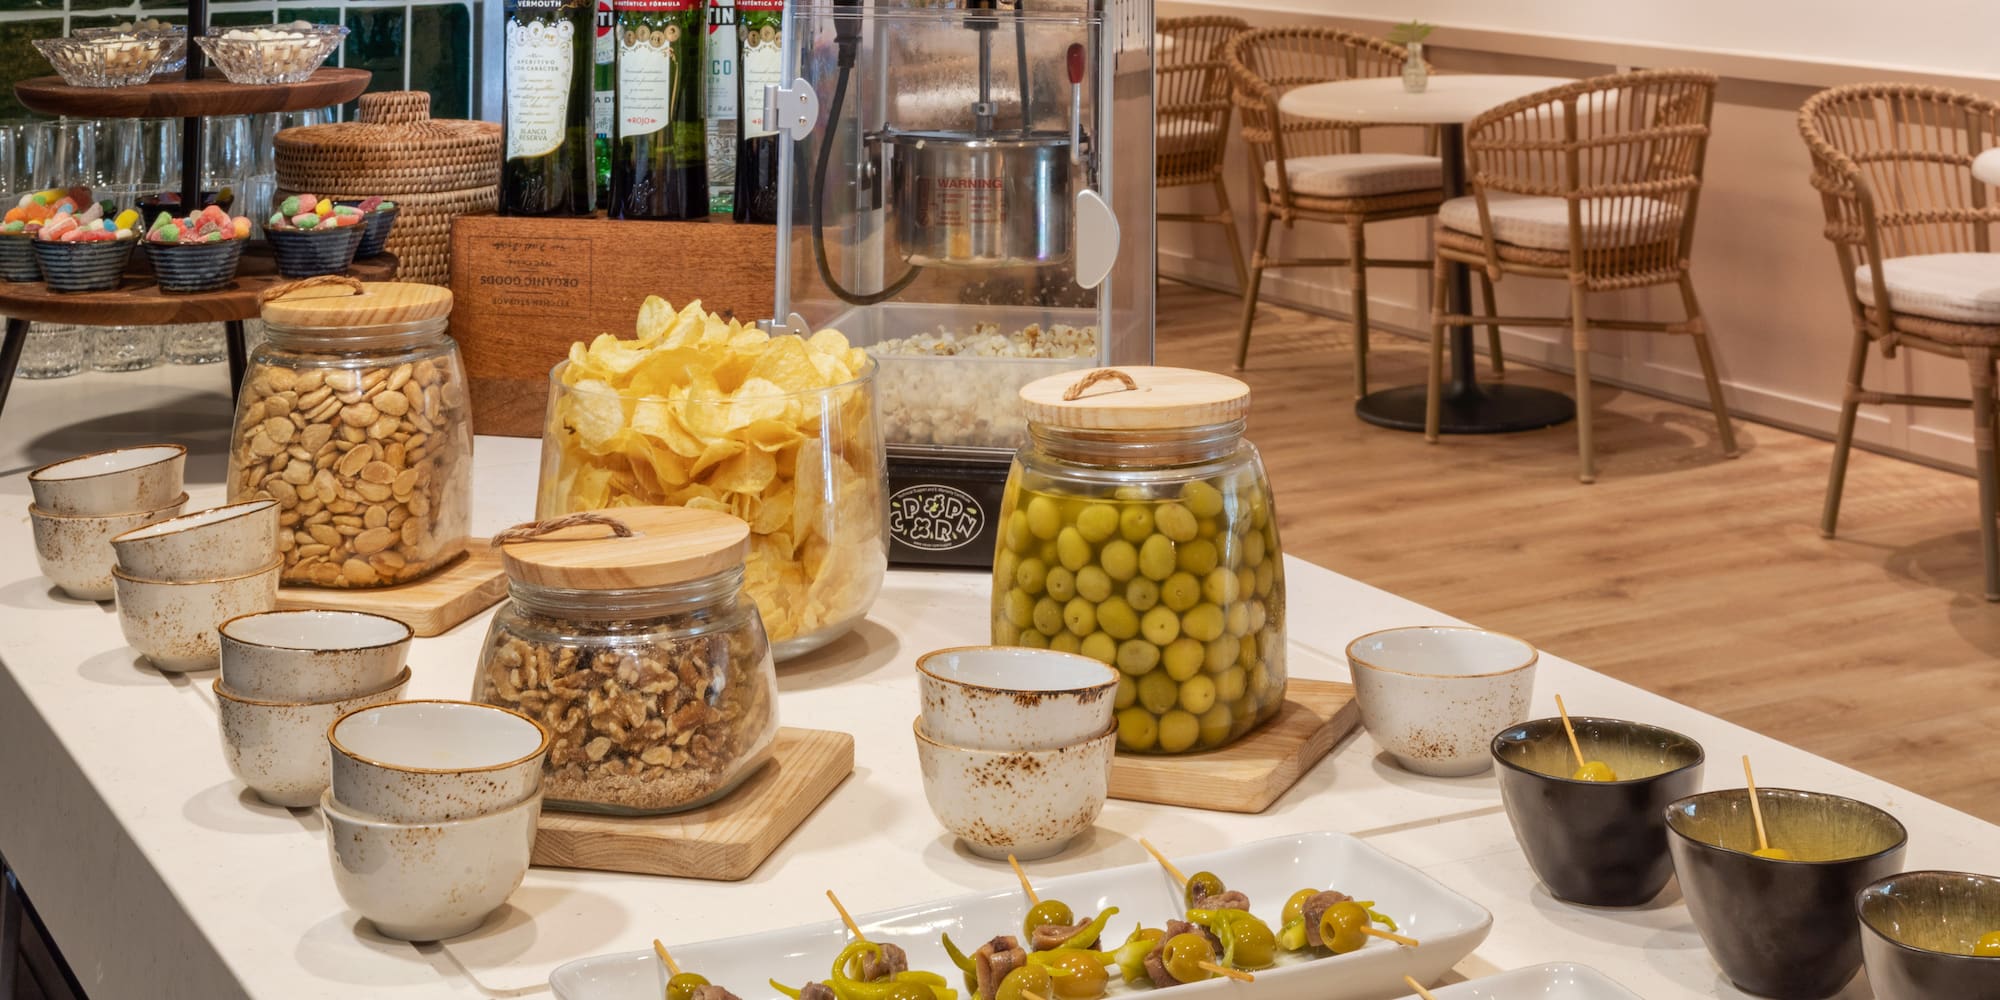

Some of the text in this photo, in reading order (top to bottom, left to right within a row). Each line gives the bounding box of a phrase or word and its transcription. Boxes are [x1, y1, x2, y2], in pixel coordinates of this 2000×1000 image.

[632, 117, 650, 125] ROJO
[938, 177, 1003, 189] WARNING
[480, 275, 579, 288] ORGANIC GOODS
